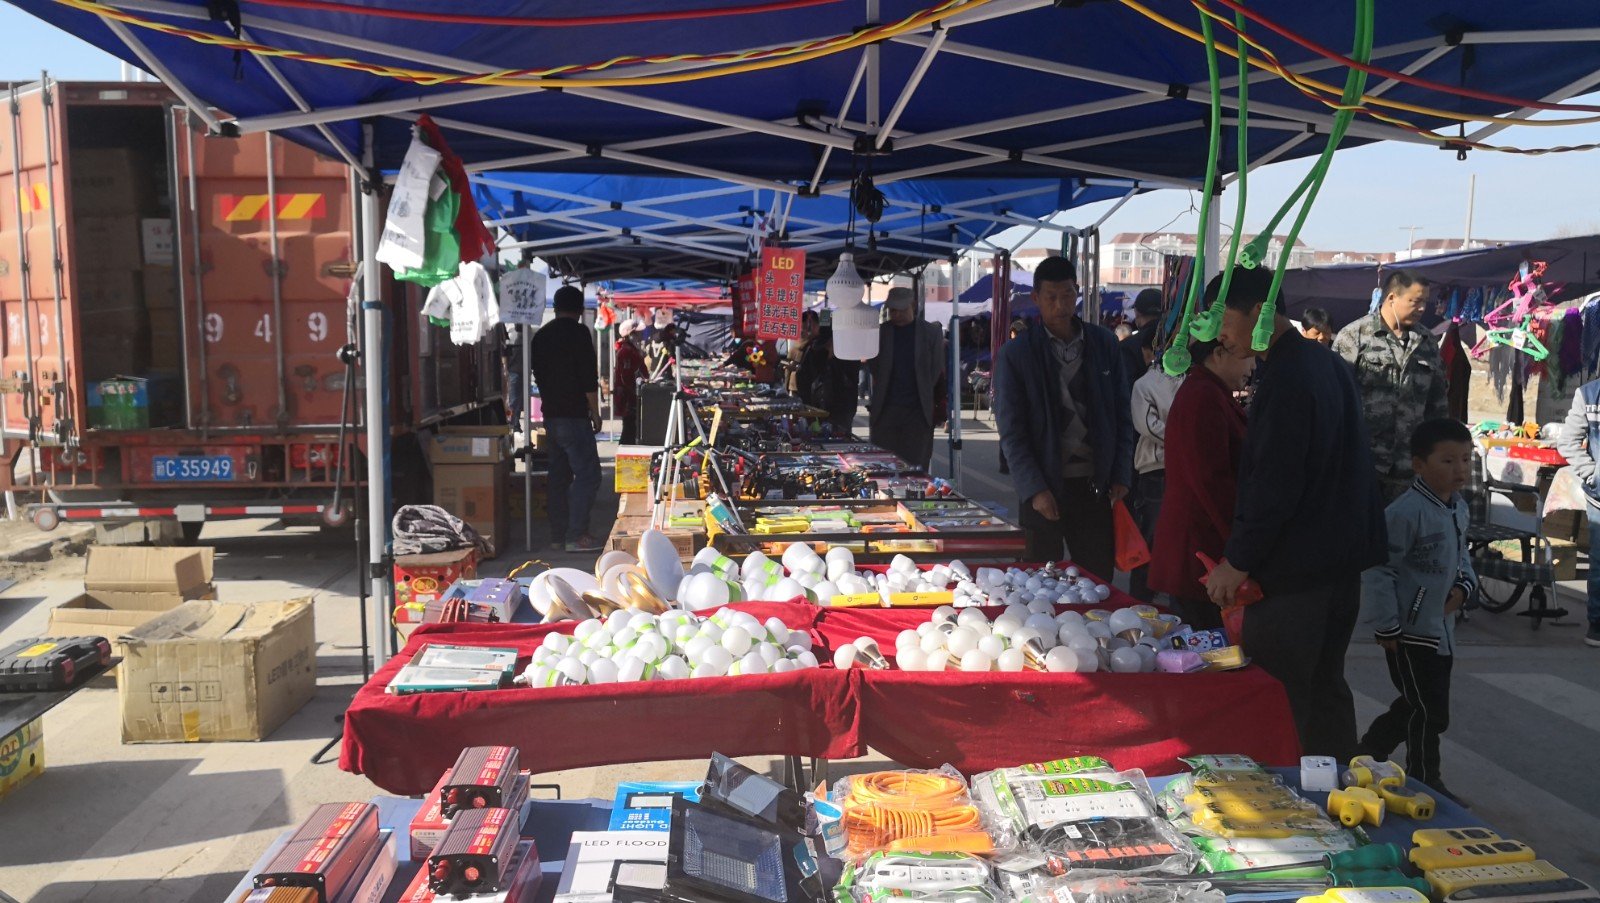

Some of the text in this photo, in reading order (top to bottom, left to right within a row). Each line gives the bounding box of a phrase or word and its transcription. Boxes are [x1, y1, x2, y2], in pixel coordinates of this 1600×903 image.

[772, 256, 795, 269] LED
[765, 287, 798, 304] 手提灯
[763, 303, 799, 321] 强光手电
